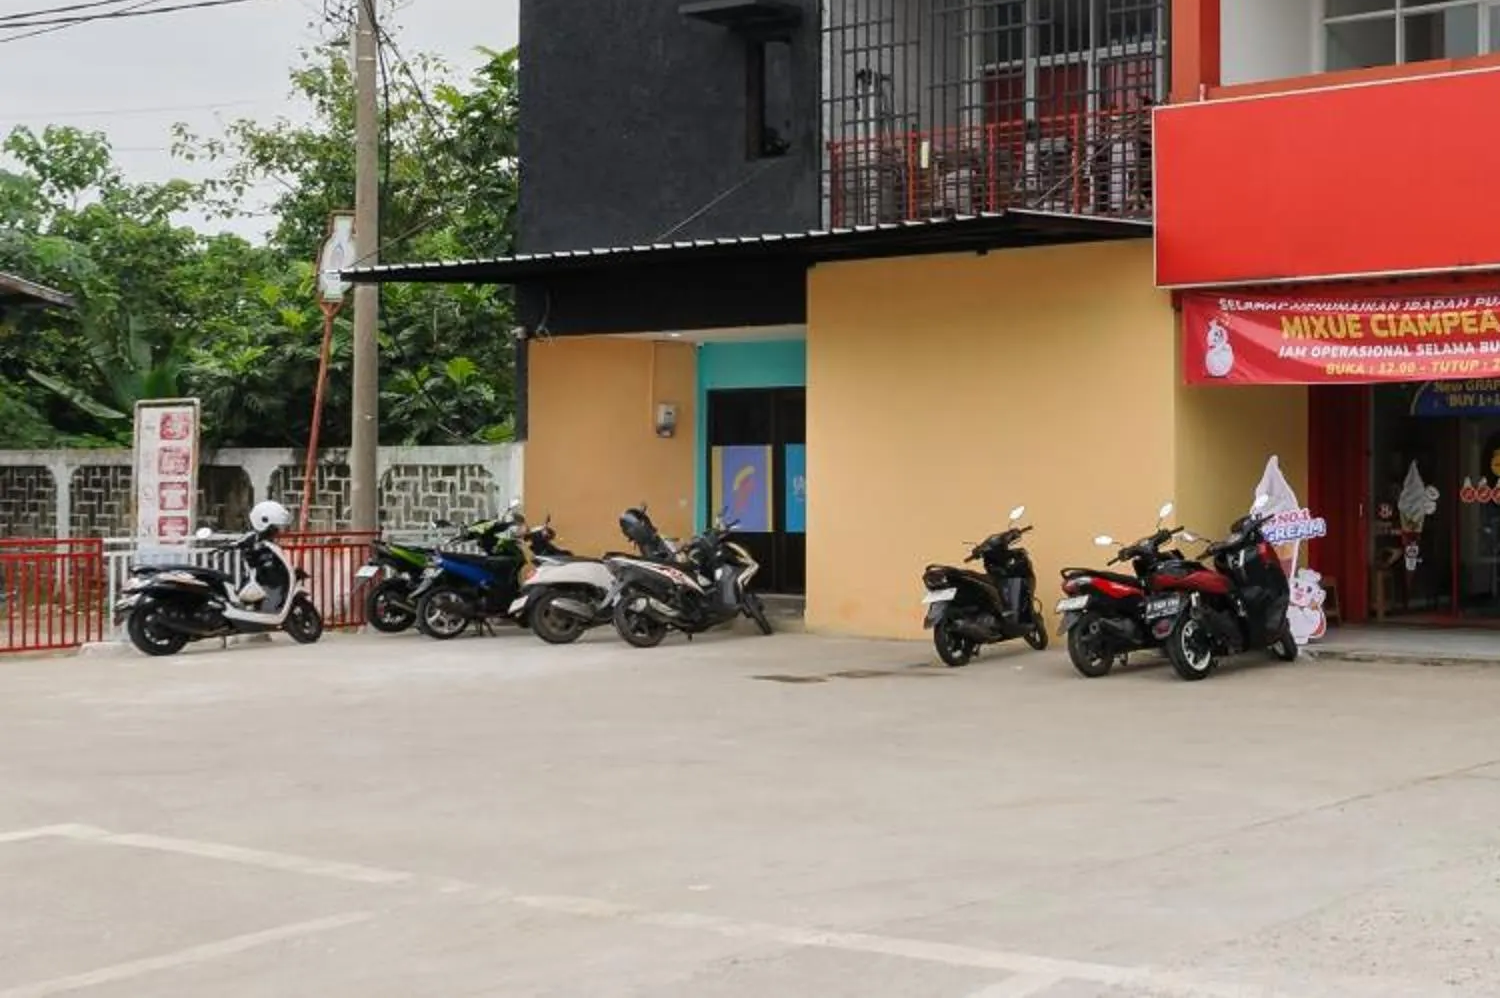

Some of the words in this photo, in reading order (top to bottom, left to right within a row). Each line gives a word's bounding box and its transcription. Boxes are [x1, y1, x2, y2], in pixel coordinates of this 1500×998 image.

[1281, 314, 1363, 339] MIXUE
[1311, 345, 1411, 358] OPERASIONAL
[1416, 342, 1475, 357] SELAMA
[1326, 363, 1365, 375] BUKA
[1431, 360, 1479, 372] TUTUP
